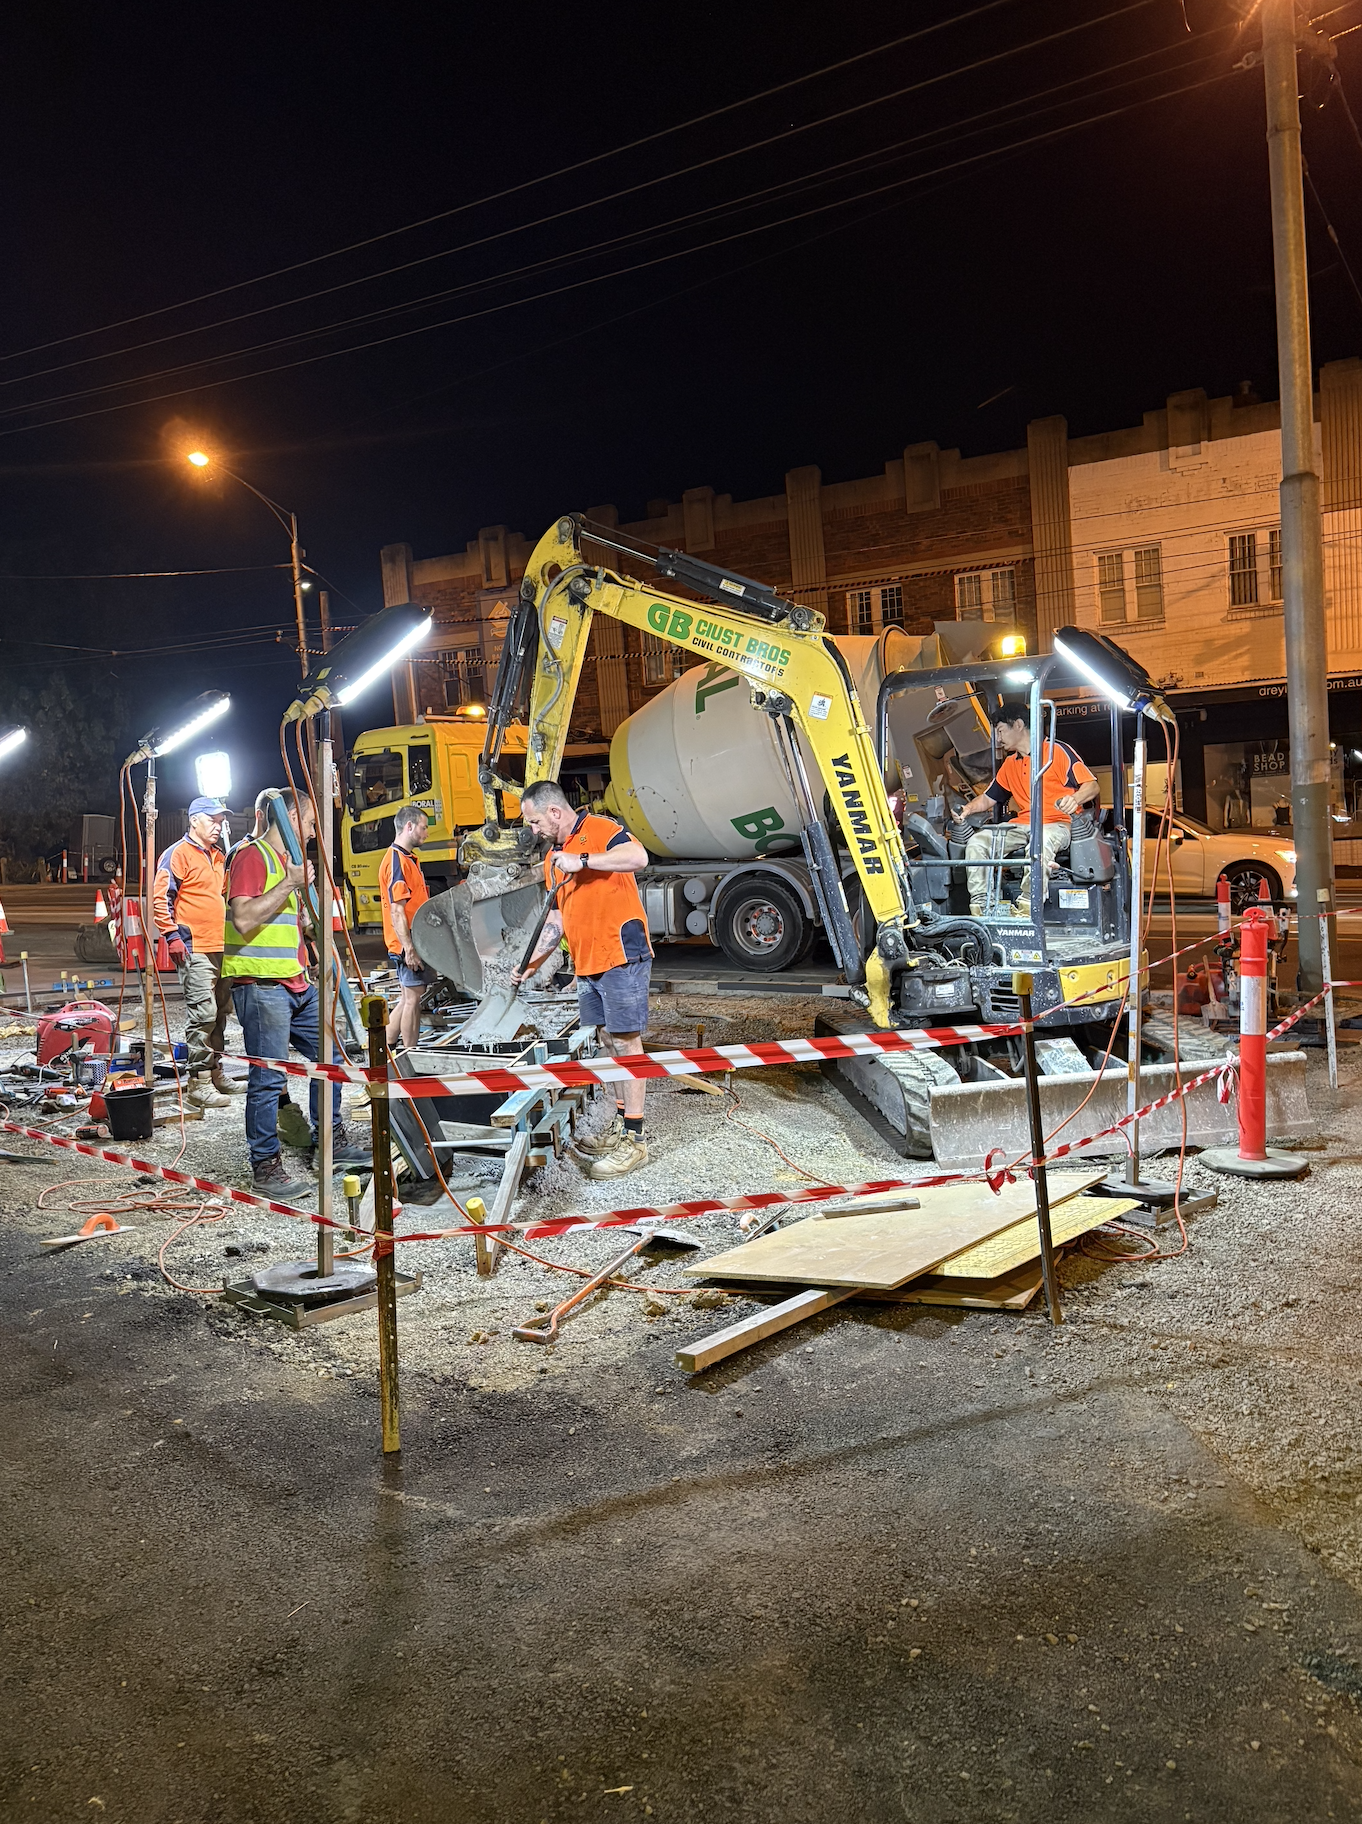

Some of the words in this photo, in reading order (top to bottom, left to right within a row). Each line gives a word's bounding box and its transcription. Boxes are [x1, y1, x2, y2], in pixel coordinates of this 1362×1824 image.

[647, 603, 694, 640] GB
[695, 619, 744, 648] CIUST
[746, 637, 791, 666] BROS
[692, 637, 714, 652] CIVIL
[1056, 704, 1088, 716] arking
[1090, 703, 1101, 713] at
[1253, 752, 1285, 763] BEAD
[1253, 761, 1286, 772] SHOP
[831, 753, 885, 875] YANMAR
[996, 929, 1035, 937] YANMAR
